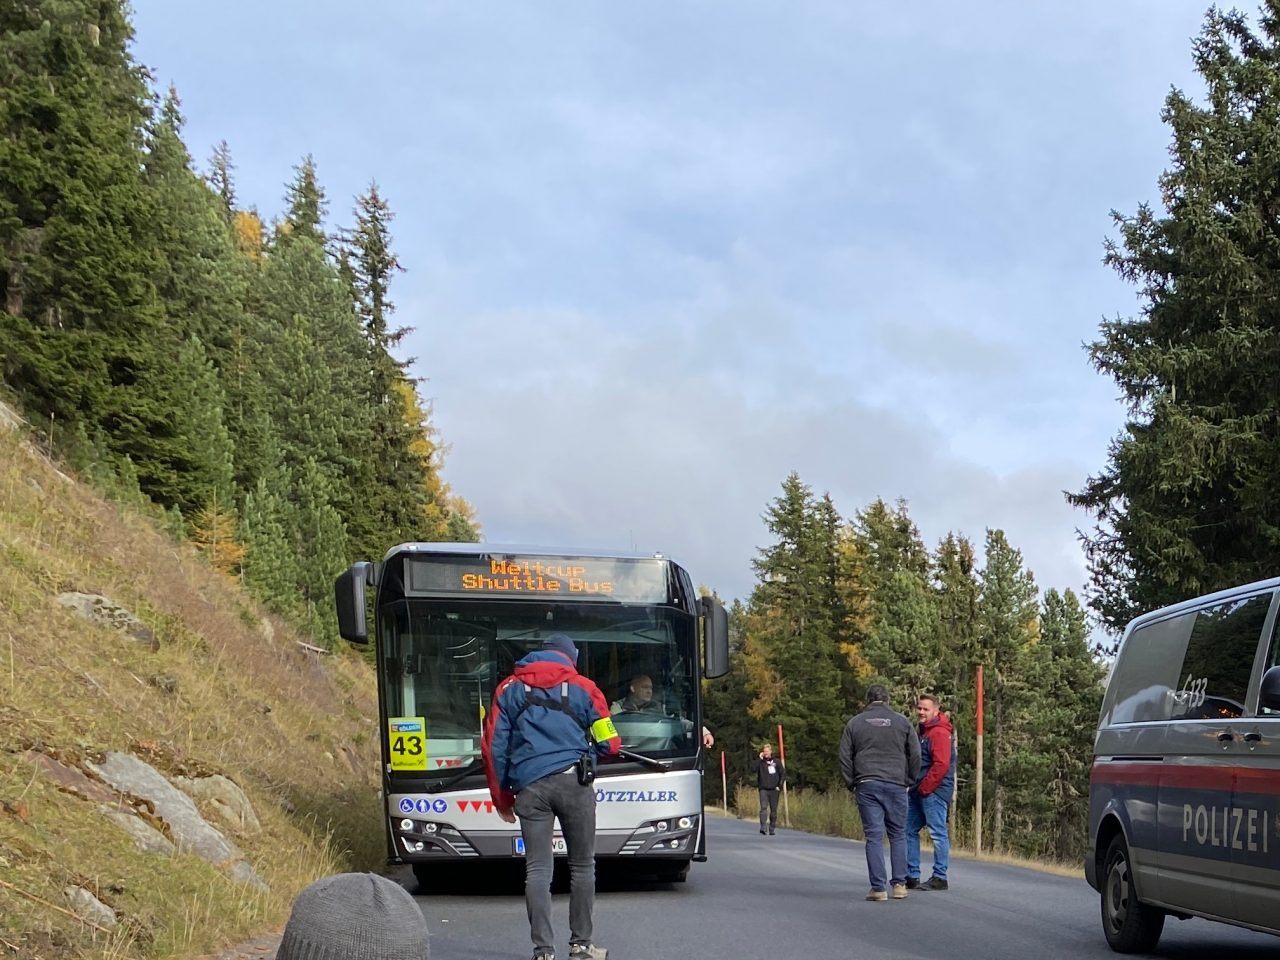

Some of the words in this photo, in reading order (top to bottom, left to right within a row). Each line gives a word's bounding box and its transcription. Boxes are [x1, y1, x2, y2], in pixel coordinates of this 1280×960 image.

[490, 560, 585, 577] Weltcup
[462, 574, 560, 591] Shuttle
[569, 578, 614, 593] Bus
[392, 735, 423, 756] 43
[596, 789, 678, 802] ÖTZTALER
[1183, 804, 1268, 853] POLIZEI
